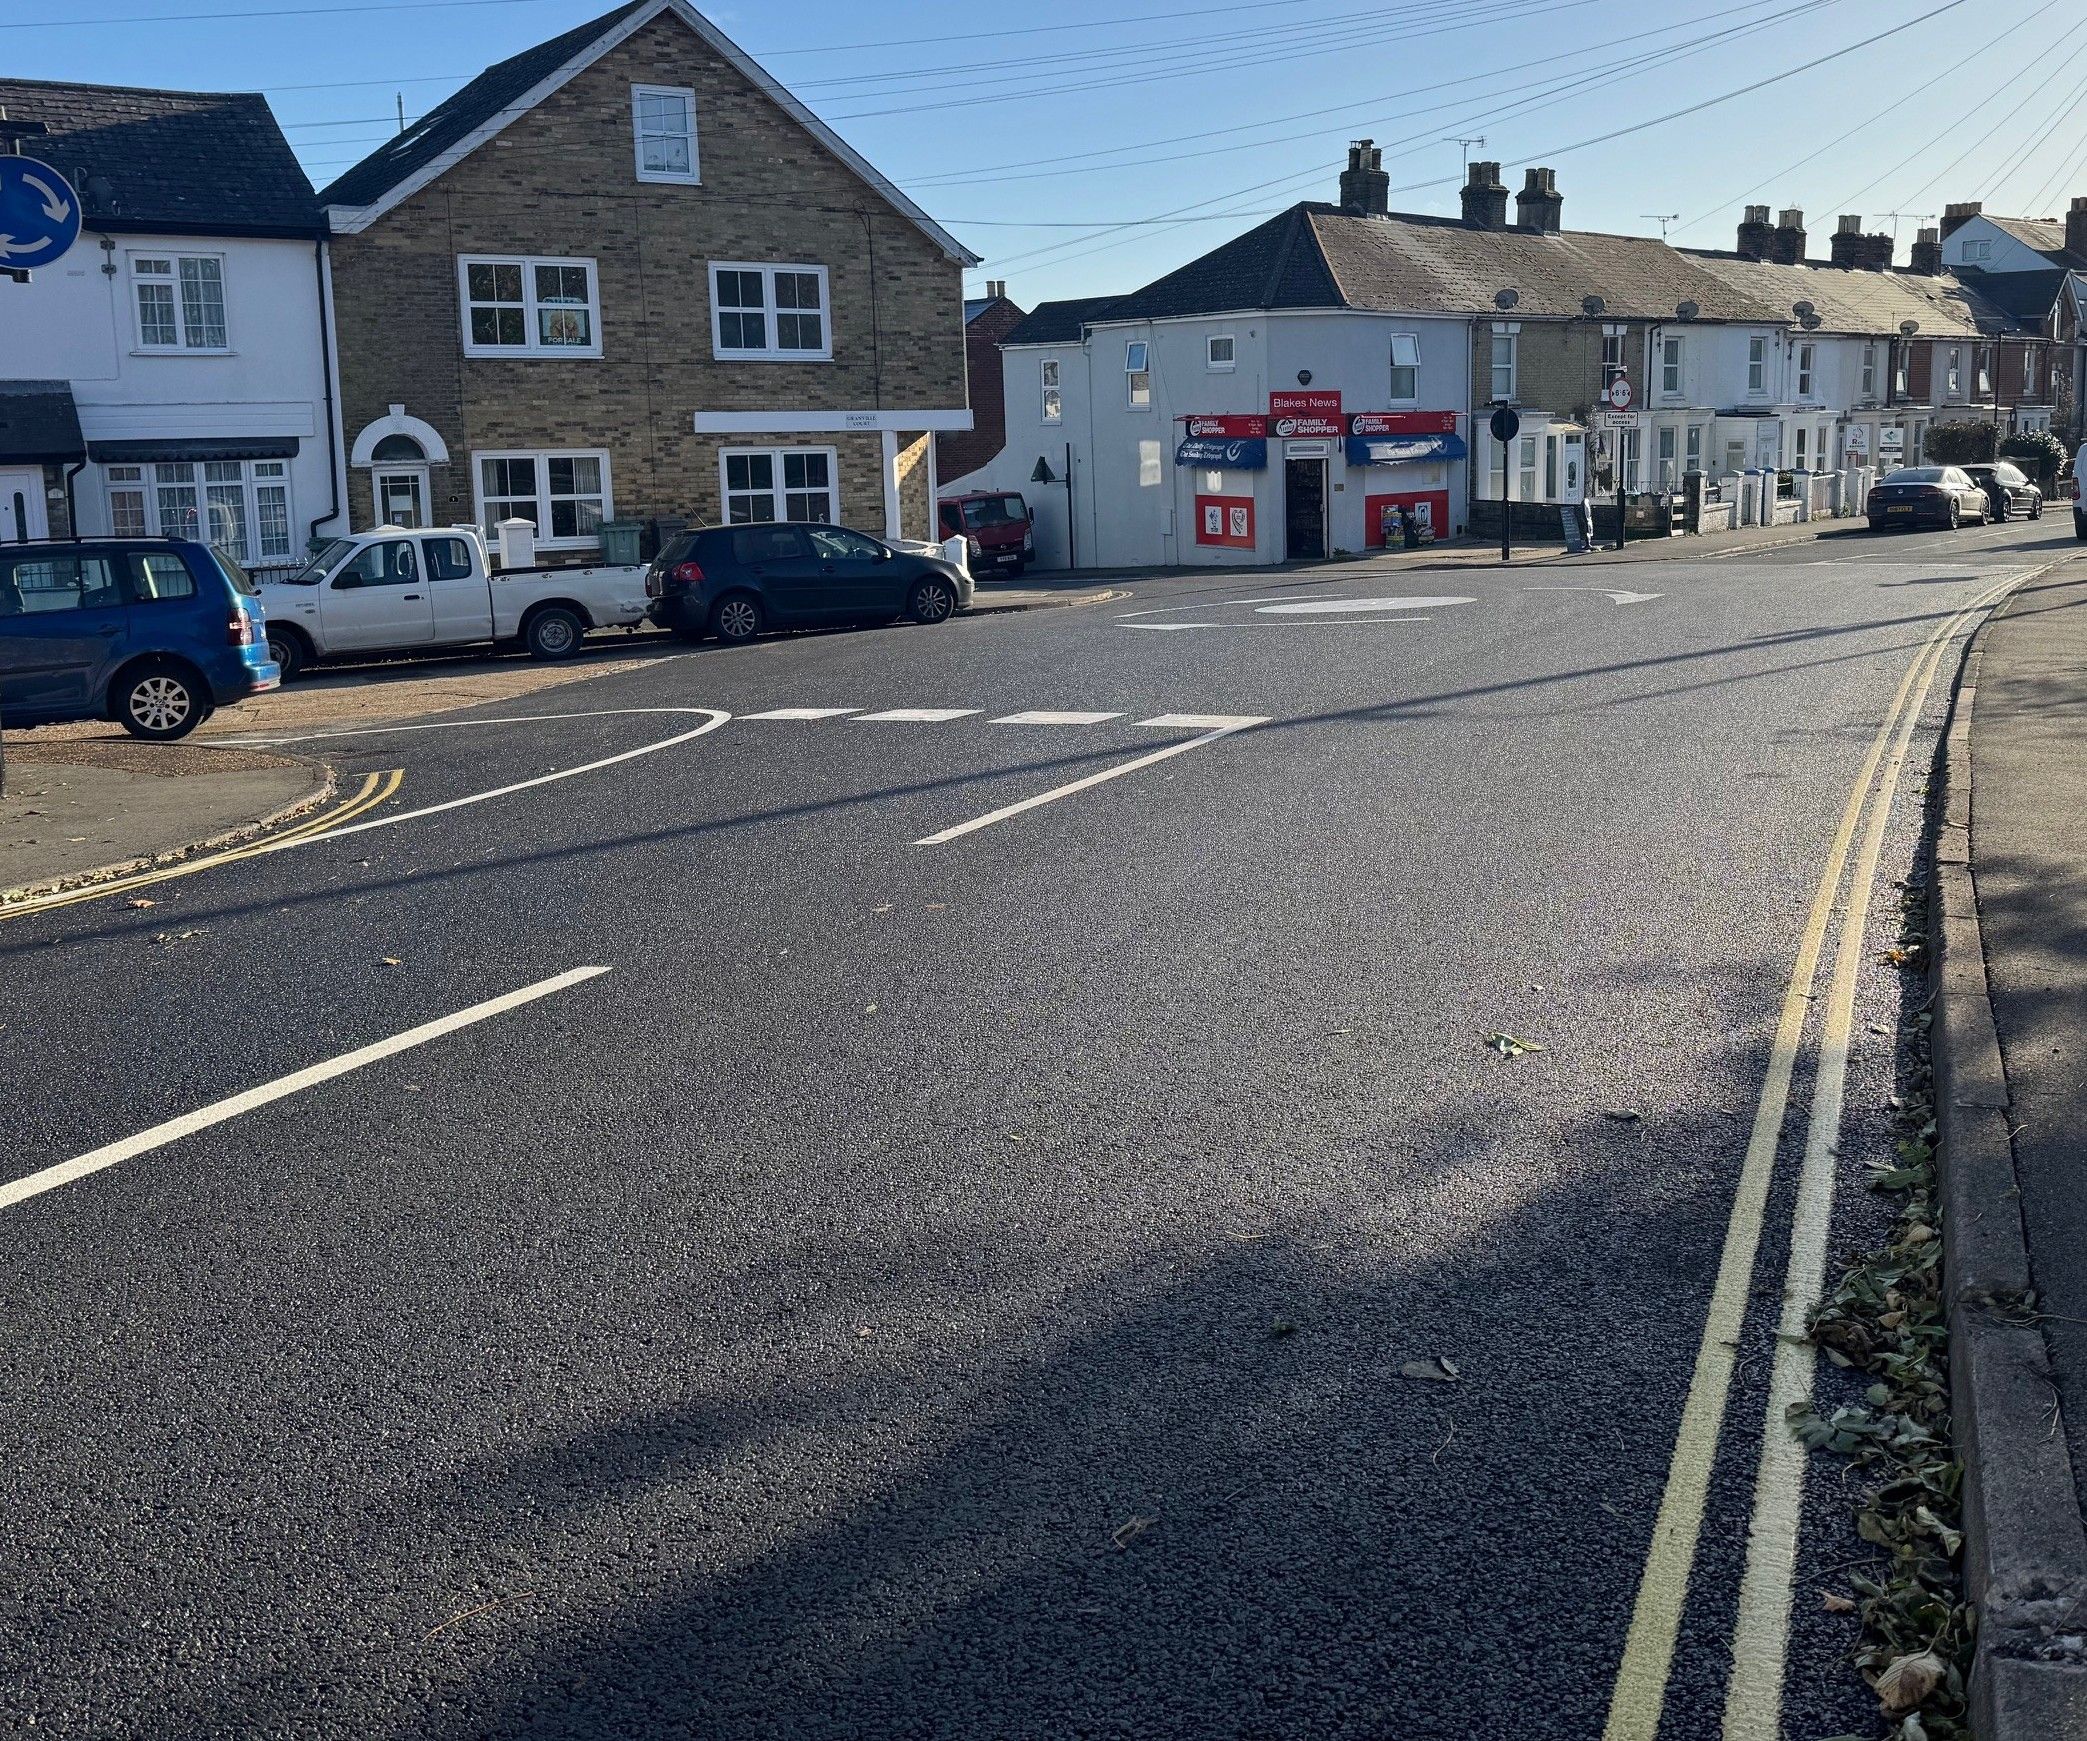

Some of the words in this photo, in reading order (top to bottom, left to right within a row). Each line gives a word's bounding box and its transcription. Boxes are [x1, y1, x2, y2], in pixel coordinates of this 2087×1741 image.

[1273, 398, 1306, 408] Blakes
[1309, 398, 1338, 407] News
[1297, 418, 1328, 426] FAMILY
[1201, 426, 1226, 434] SHOPPER
[1297, 425, 1339, 434] SHOPPER
[1365, 424, 1390, 432] SHOPPER
